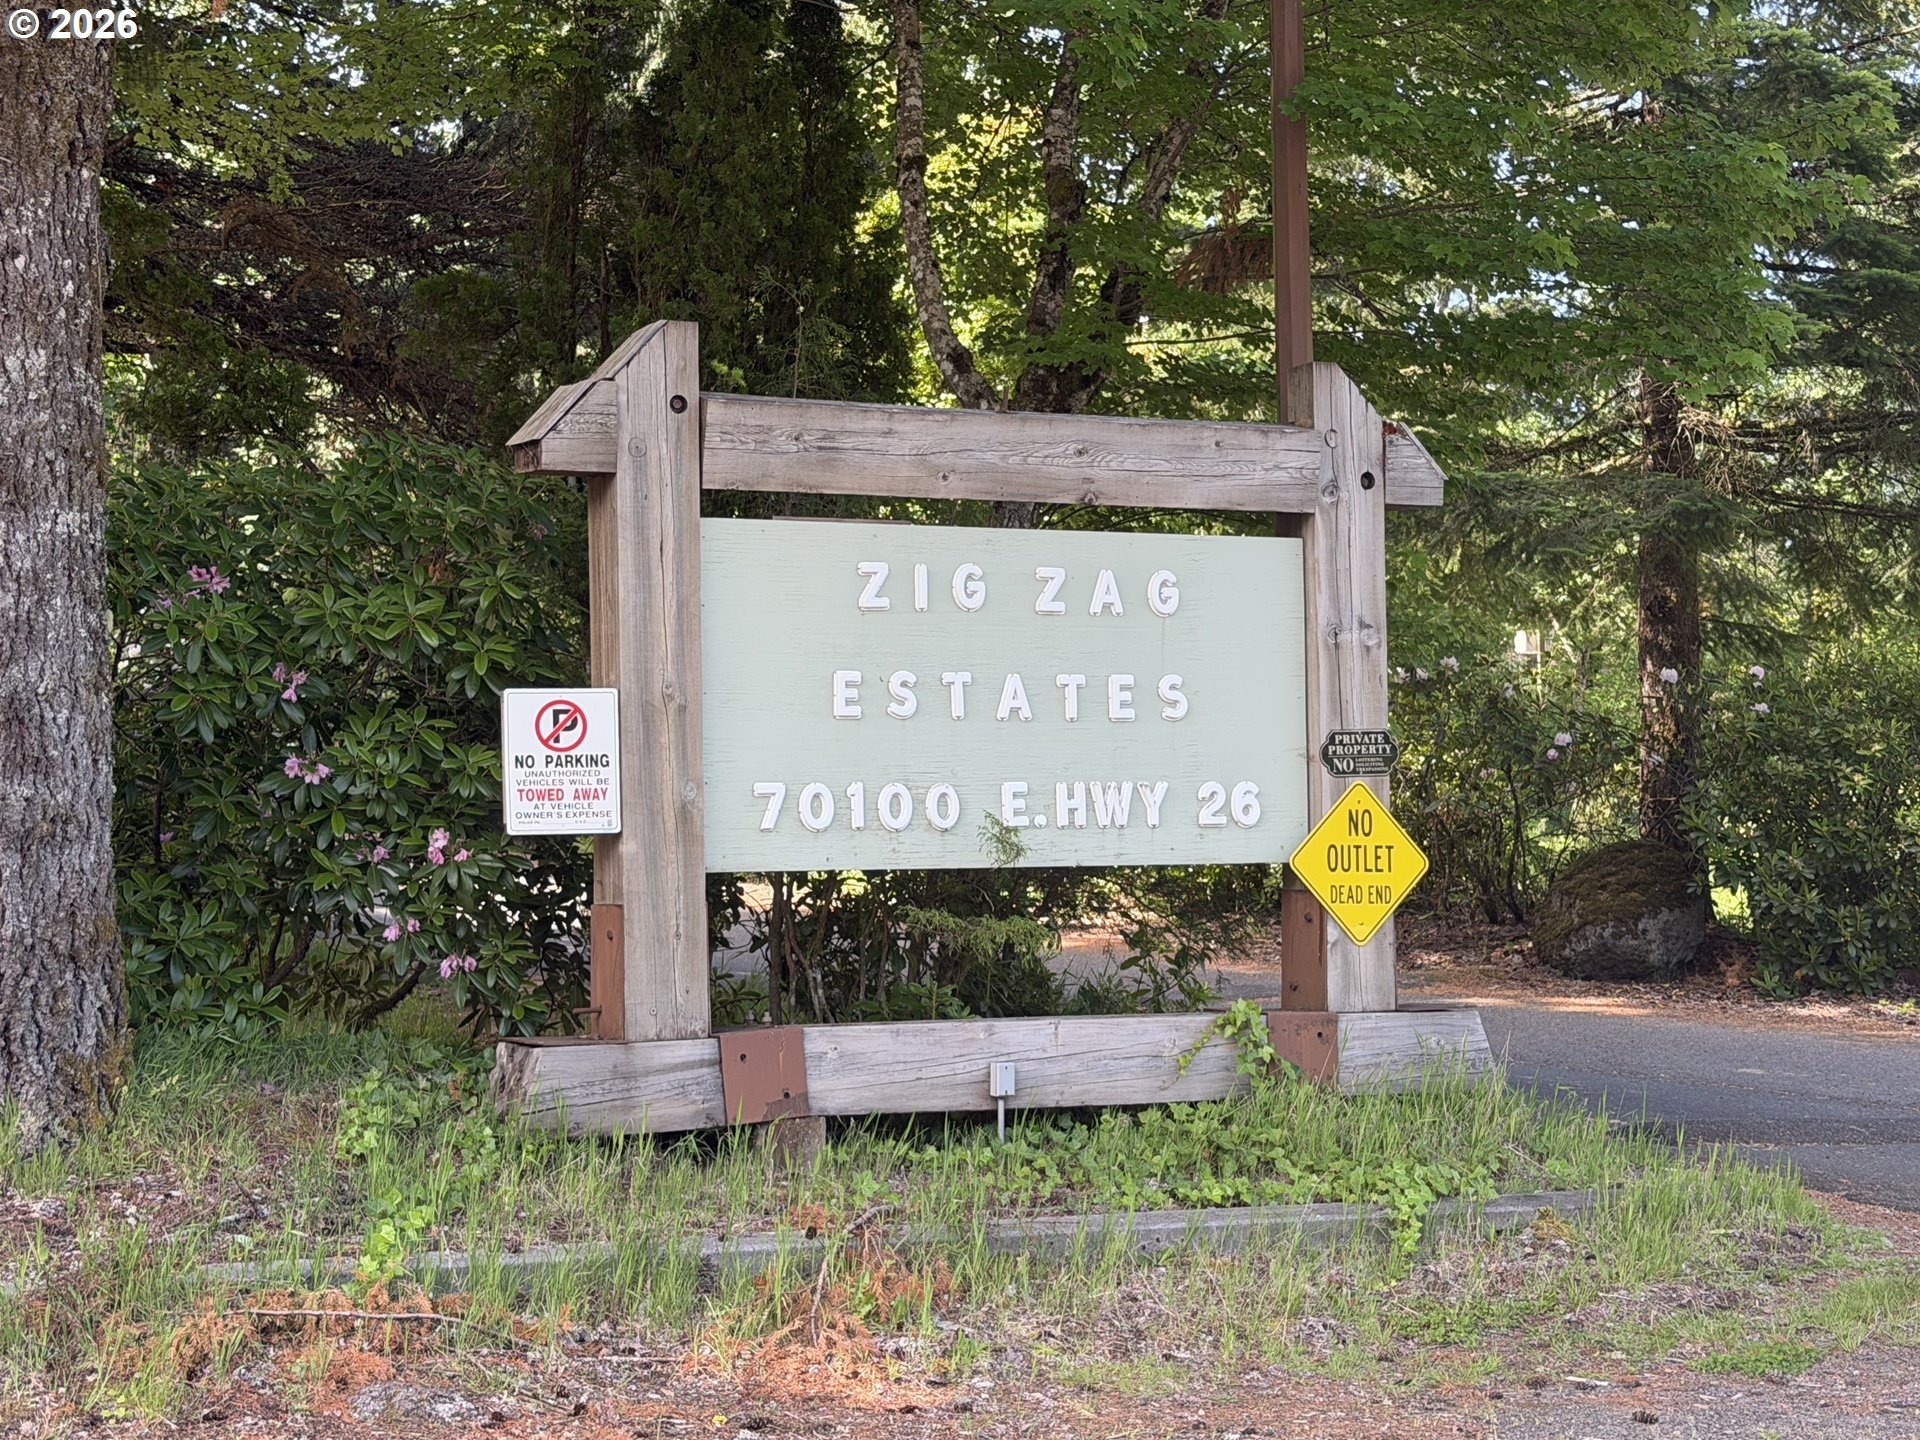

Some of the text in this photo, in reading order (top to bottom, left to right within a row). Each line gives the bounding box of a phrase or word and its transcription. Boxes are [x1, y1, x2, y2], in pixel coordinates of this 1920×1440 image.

[857, 561, 1181, 618] ZIG ZAG
[832, 669, 1190, 722] ESTATES
[1334, 733, 1385, 745] PRIVATE
[1327, 744, 1392, 755] PROPERTY
[514, 753, 610, 769] NO PARKING
[1332, 757, 1354, 773] NO
[524, 769, 601, 778] UNAUTHORIZED
[516, 777, 610, 787] VEHICLES WILL BE
[516, 787, 609, 802] TOWED AWAY
[550, 802, 594, 810] VEHICLE
[753, 781, 961, 833] 70100
[1198, 780, 1261, 829] 26
[515, 810, 613, 819] OWNER'S EXPENSE
[1348, 809, 1373, 837] NO
[1327, 844, 1394, 873] OUTLET
[1330, 884, 1392, 905] DEAD END
